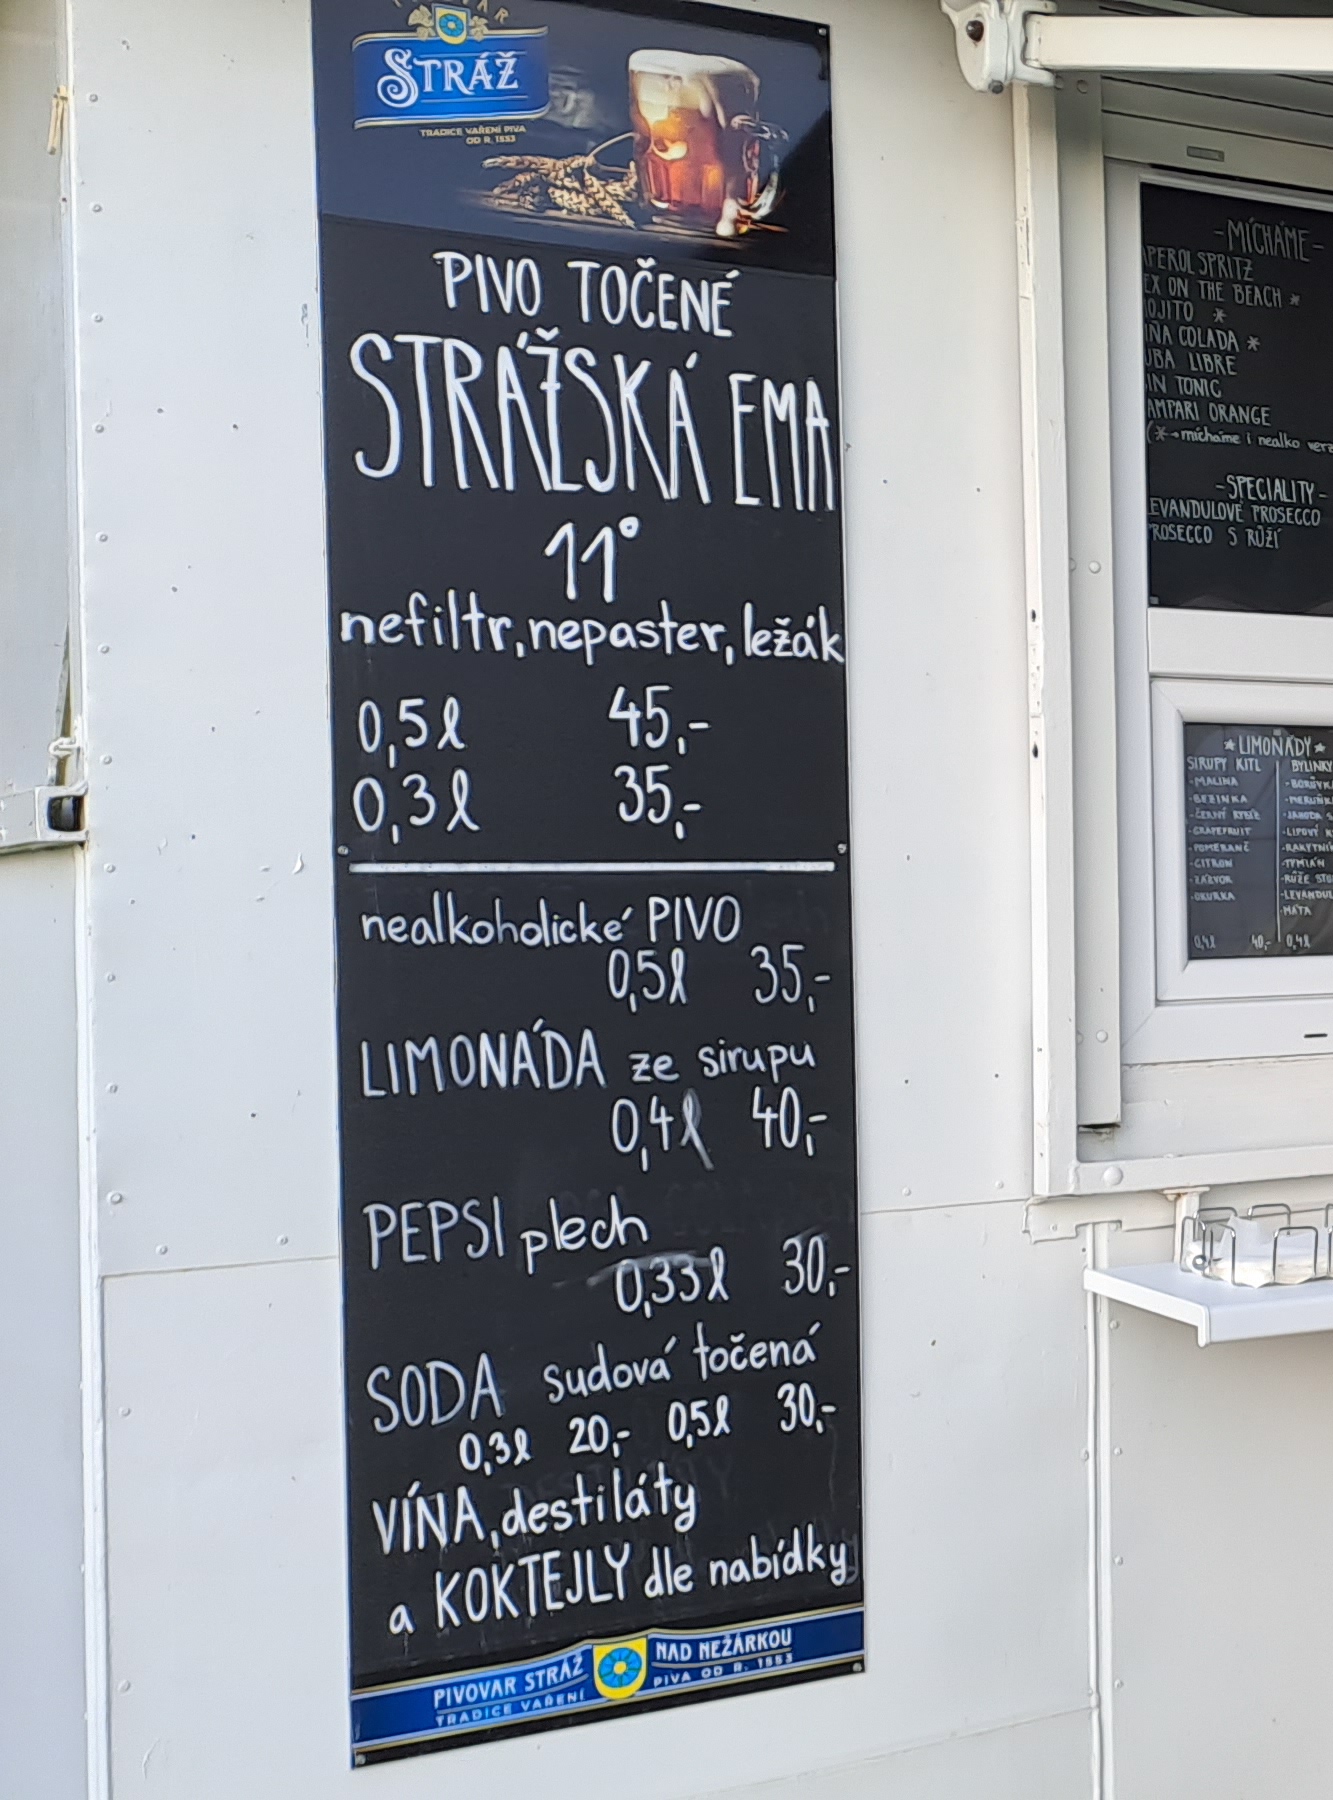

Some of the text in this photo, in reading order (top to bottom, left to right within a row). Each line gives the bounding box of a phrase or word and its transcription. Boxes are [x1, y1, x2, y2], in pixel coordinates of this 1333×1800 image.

[376, 48, 519, 108] STRÁŽ
[1198, 252, 1254, 282] SPRITZ
[432, 250, 742, 337] PIVO TOČENÉ
[1144, 273, 1283, 308] EX ON THE BEACH
[1144, 299, 1194, 322] OJITO
[1144, 320, 1240, 352] IÑA COLADA
[1145, 347, 1238, 377] UBA LIBRE
[1145, 373, 1222, 398] IN TONIC
[349, 326, 834, 511] STRÁŽSKÁ EMA
[1147, 398, 1199, 422] AMPARI
[1208, 403, 1271, 427] ORANGE
[1258, 430, 1300, 450] nealko
[1251, 503, 1322, 527] PROSECCO
[1149, 523, 1283, 550] ROSECCO S RŮŽÍ
[1238, 734, 1312, 757] LIMONÁDY
[1188, 756, 1261, 772] SIRUPY KITL
[1291, 759, 1332, 774] BYLINKY
[360, 890, 741, 947] nealkoholické PIVO
[361, 1019, 817, 1097] LIMONÁDA ze sirupu
[363, 1194, 650, 1275] PEPSI plech
[366, 1322, 821, 1436] SODA sudová točená
[389, 1524, 848, 1635] a KOKTEJLY dle nabídky
[655, 1628, 792, 1662] NAD NEŽÁRKOU
[434, 1654, 585, 1708] PIVOVAR STRÁŽ
[654, 1671, 692, 1687] PIVA
[702, 1666, 723, 1679] OD
[436, 1702, 513, 1728] TRADICE
